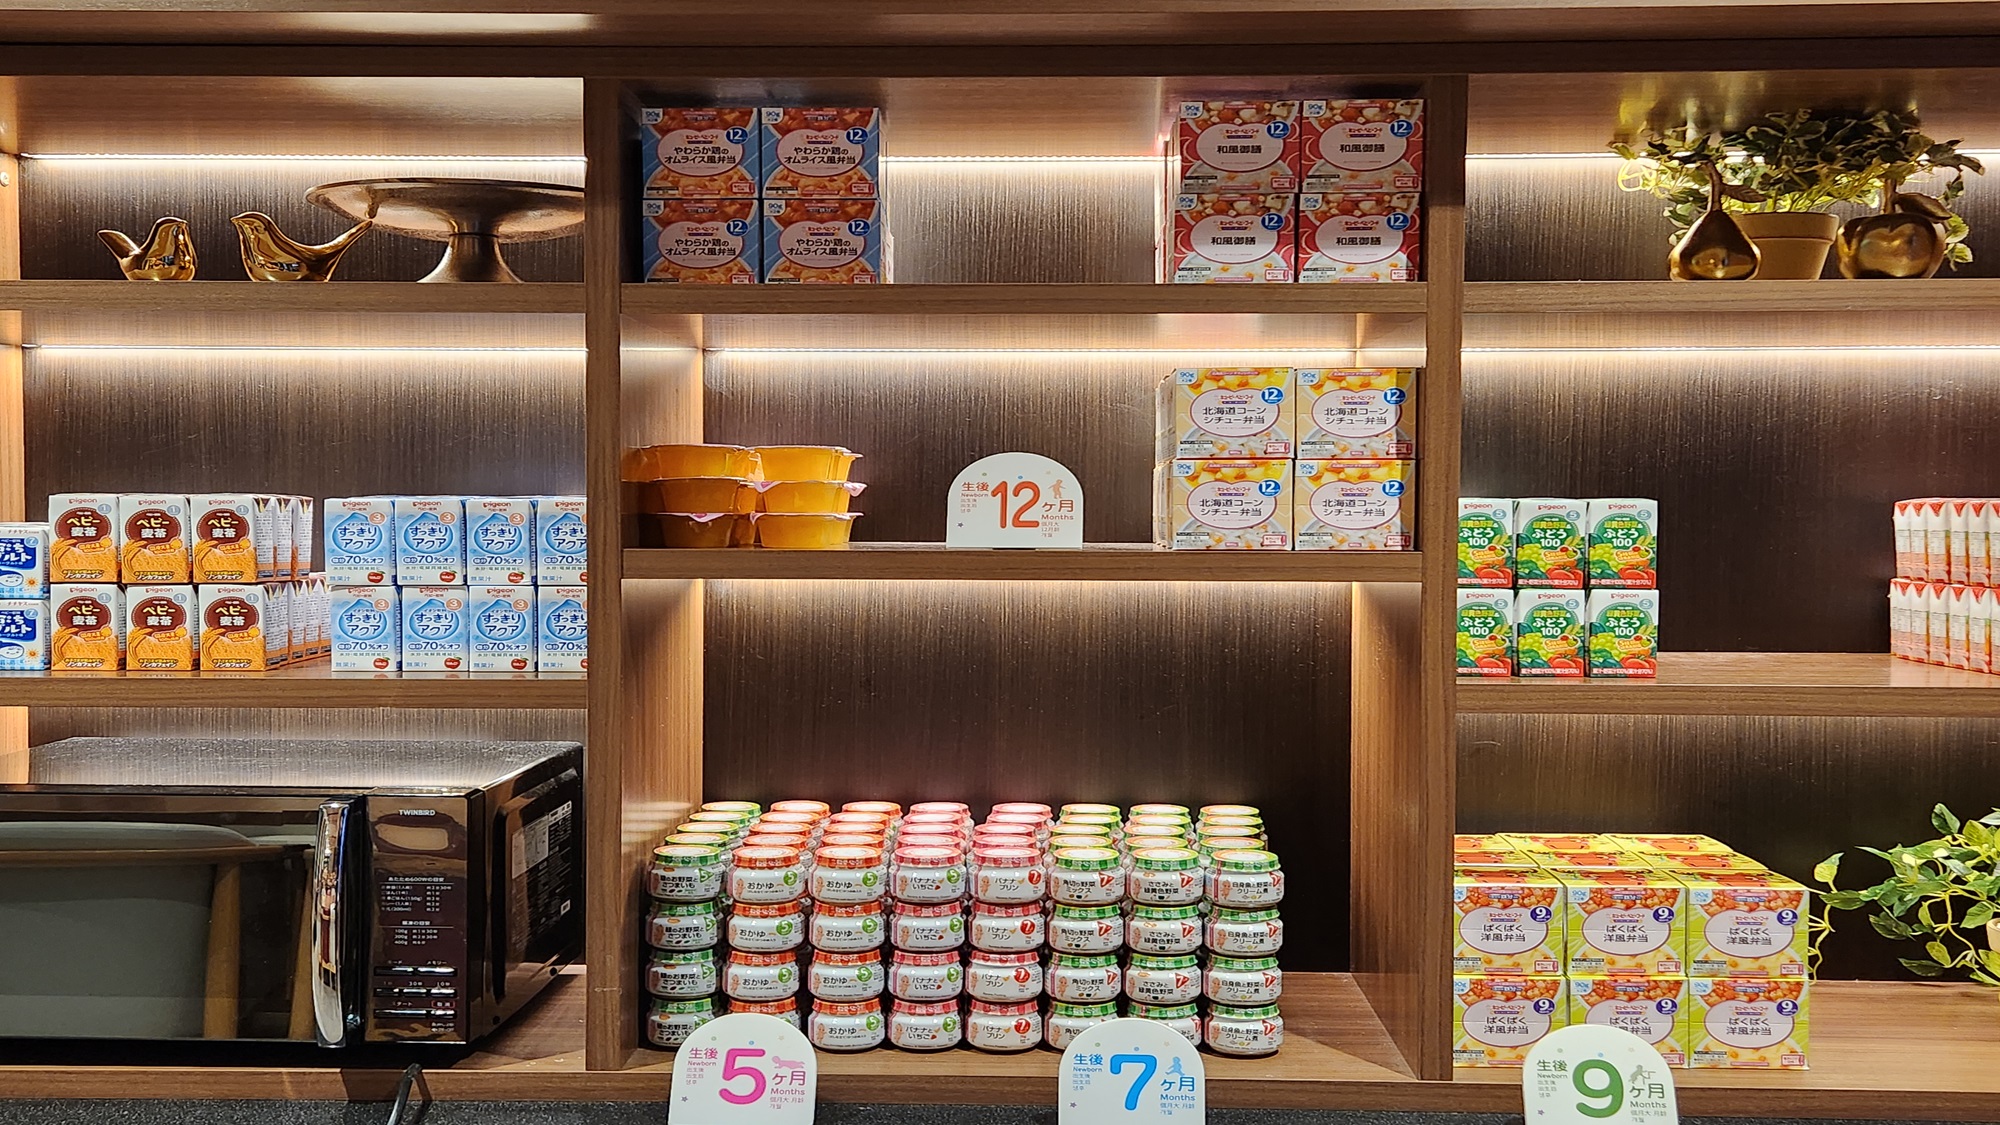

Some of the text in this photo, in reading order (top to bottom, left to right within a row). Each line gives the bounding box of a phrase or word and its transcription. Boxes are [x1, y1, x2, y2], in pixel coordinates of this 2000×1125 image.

[1270, 123, 1283, 134] 12
[1394, 122, 1407, 132] 12
[729, 130, 742, 140] 12
[849, 130, 862, 140] 12
[665, 155, 735, 164] オムライス風弁当
[1211, 236, 1256, 245] 和風御膳
[1336, 236, 1381, 245] 和風御膳
[665, 247, 735, 256] オムライス風弁当
[787, 247, 857, 256] オムライス風弁当
[1204, 416, 1264, 425] シチュー弁当
[1326, 416, 1386, 425] シチュー弁当
[962, 482, 989, 492] 生後
[991, 481, 1040, 529] 12
[1199, 498, 1263, 507] 北海道コーン
[1201, 507, 1261, 516] シチュー弁当
[1324, 508, 1385, 517] シチュー弁当
[67, 517, 100, 526] ベビー
[212, 528, 235, 537] 麦茶
[338, 527, 376, 538] すっきり
[410, 527, 447, 537] すっきり
[480, 527, 517, 538] すっきり
[1460, 529, 1494, 538] ぶどう
[1533, 529, 1566, 538] ぶどう
[1604, 529, 1639, 538] ぶどう
[344, 539, 374, 550] アクア
[413, 539, 445, 549] アクア
[482, 539, 515, 550] アクア
[147, 617, 172, 626] 麦茶
[345, 613, 382, 624] すっきり
[415, 613, 453, 623] すっきり
[348, 625, 380, 636] アクア
[419, 625, 452, 635] アクア
[867, 873, 873, 882] 5
[1032, 871, 1037, 882] 7
[1102, 875, 1107, 885] 7
[1537, 909, 1545, 918] 9
[1659, 910, 1666, 919] 9
[1784, 911, 1791, 921] 9
[1604, 933, 1648, 942] 洋風弁当
[1541, 1000, 1549, 1010] 9
[1662, 1001, 1670, 1011] 9
[689, 1048, 718, 1059] 生後
[1073, 1053, 1103, 1066] 生後
[1537, 1060, 1567, 1072] 生後
[719, 1049, 767, 1104] 5
[1110, 1054, 1157, 1111] 7
[1572, 1059, 1624, 1118] 9
